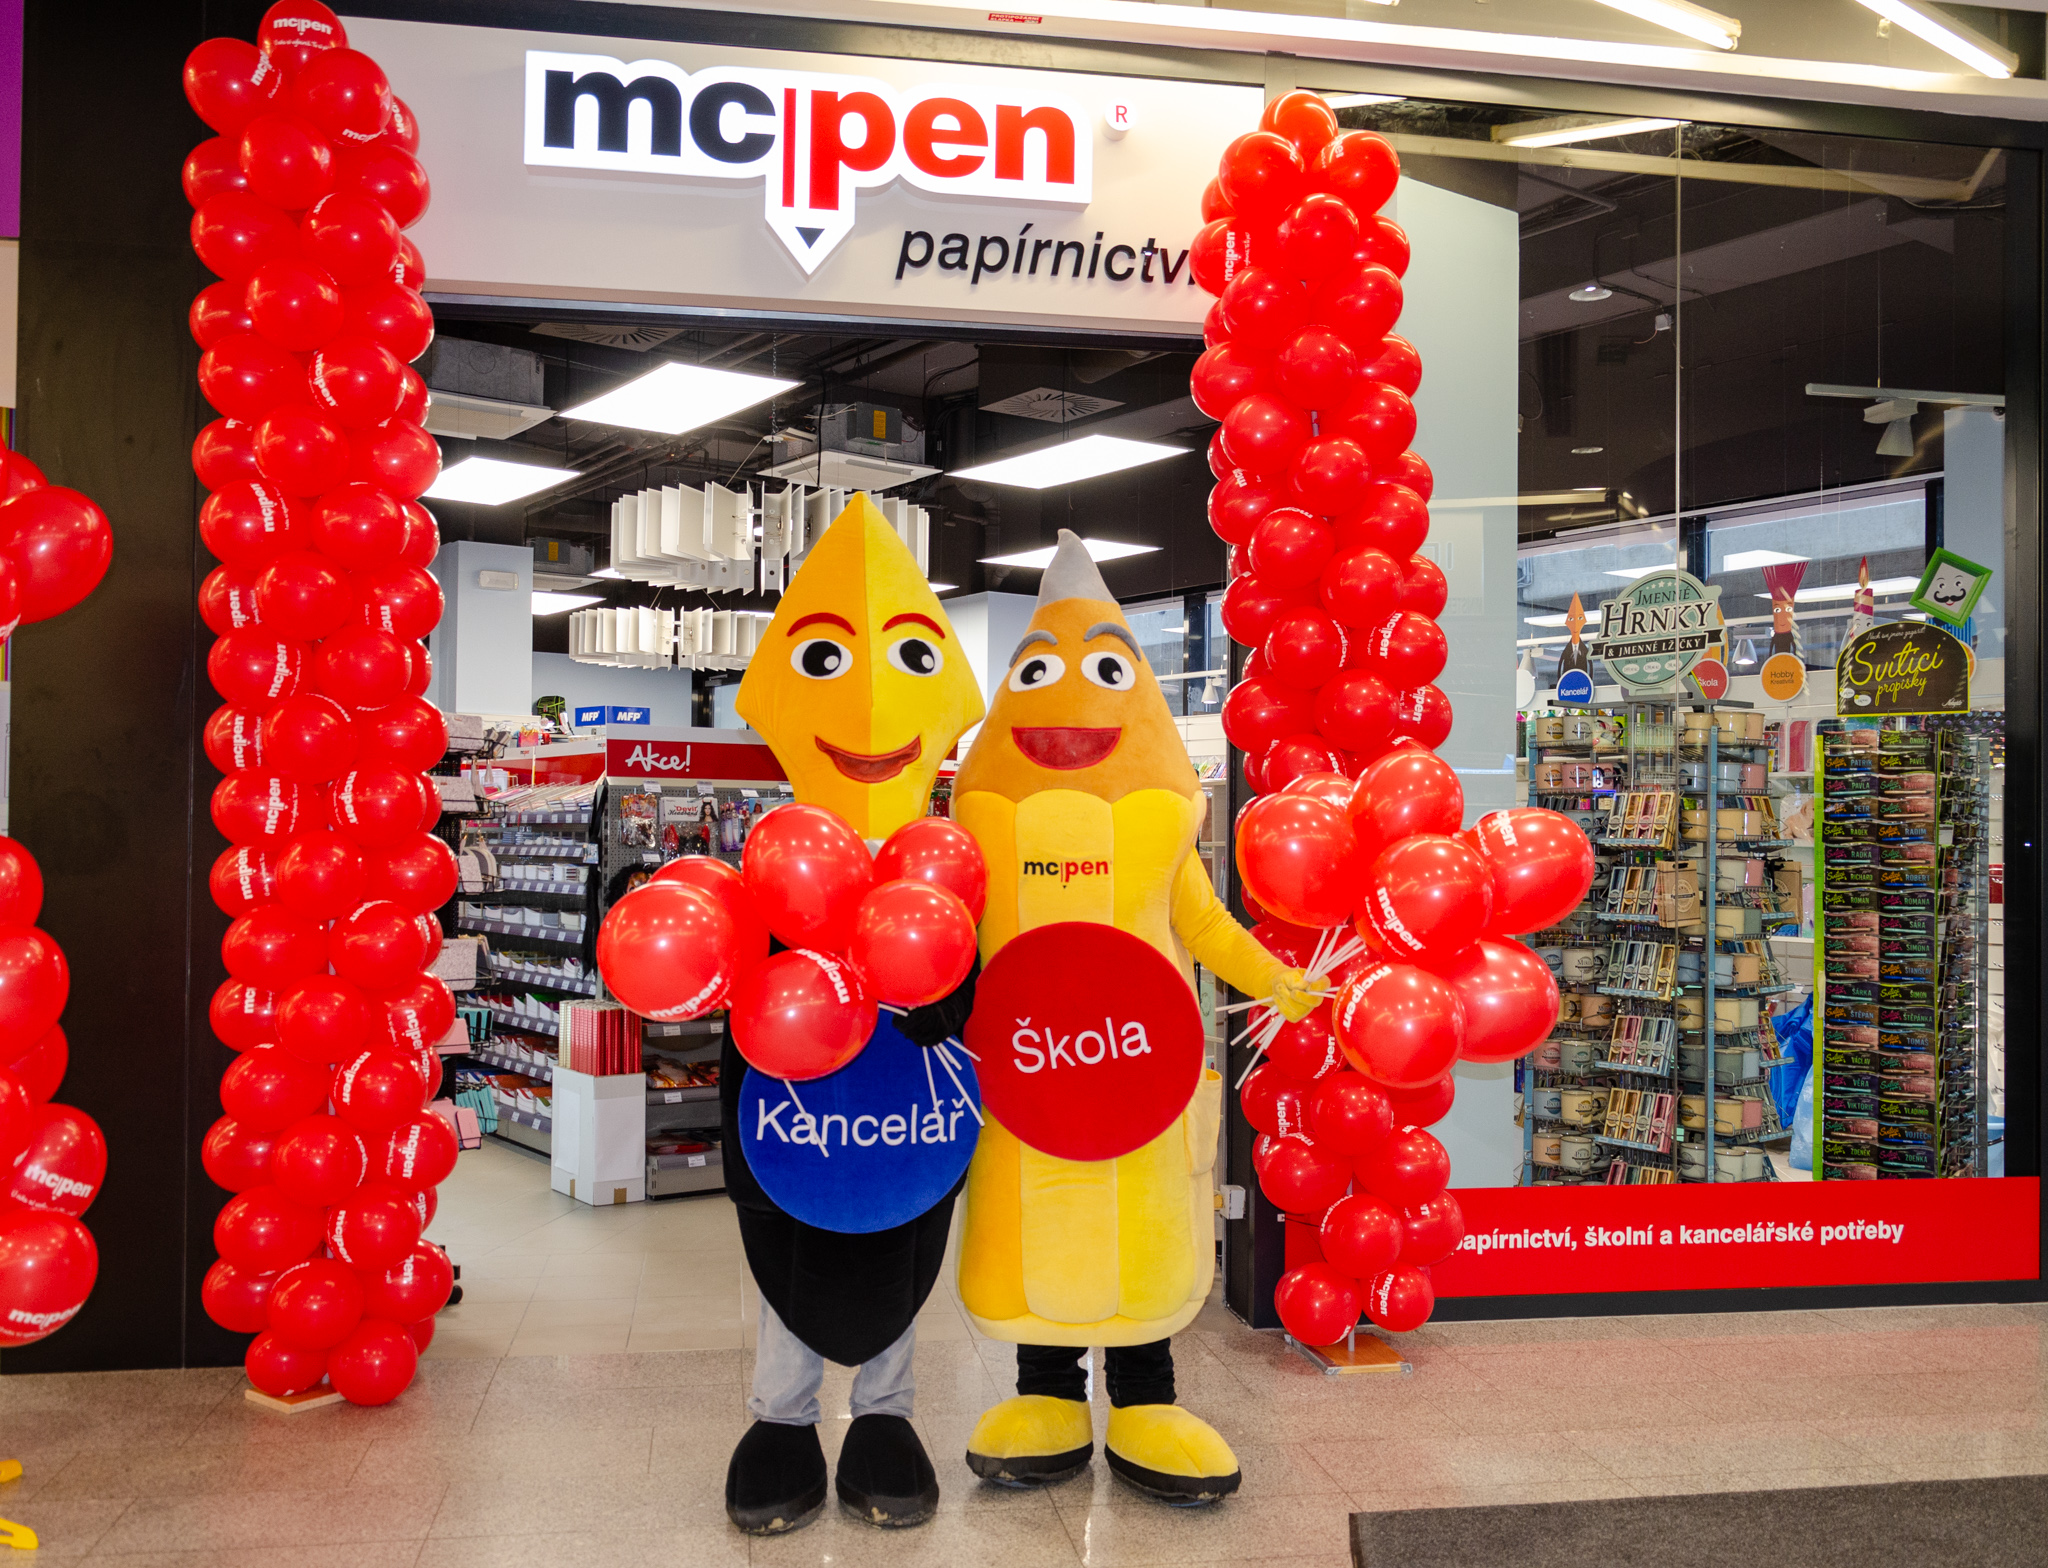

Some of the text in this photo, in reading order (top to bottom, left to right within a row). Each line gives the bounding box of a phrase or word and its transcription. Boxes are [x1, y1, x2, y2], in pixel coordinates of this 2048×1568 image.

[273, 17, 333, 35] mcpen
[543, 69, 1076, 211] mcpen
[896, 223, 1195, 285] papírnictv
[1223, 230, 1238, 282] mcpen
[313, 351, 338, 407] mcpen
[250, 483, 277, 532] mcpen
[230, 590, 248, 629] cpen
[1635, 586, 1690, 606] JMENNÉ
[1380, 612, 1403, 659] mcpen
[1601, 601, 1713, 638] HRNKY
[268, 642, 289, 697] mcpen
[1607, 638, 1701, 657] & JMENNÉ LŽČKY
[1560, 686, 1589, 697] Kancelář
[1770, 671, 1795, 679] Hobby
[1875, 668, 1928, 706] propisky
[581, 711, 599, 722] MFP
[617, 711, 641, 722] MFP
[1412, 686, 1426, 722] cpen
[232, 715, 247, 768] mcpen
[625, 742, 692, 773] Akce!
[264, 778, 284, 834] mcpen
[340, 771, 359, 824] mcpen
[239, 847, 255, 900] mcpen
[1023, 860, 1109, 883] mcpen
[1376, 886, 1427, 951] mcpen
[650, 973, 724, 1019] mcpen
[796, 948, 851, 1004] mcpen
[1343, 966, 1393, 1033] mcpen
[1012, 1017, 1152, 1074] Škola
[1312, 1036, 1336, 1080] mcpen
[343, 1051, 371, 1105] mcpen
[756, 1097, 967, 1147] Kancelář
[402, 1125, 421, 1179] mcpen
[24, 1164, 95, 1199] mcpen
[1584, 1225, 1653, 1247] školní
[1659, 1229, 1673, 1244] a
[1679, 1221, 1815, 1244] kancelářské
[1820, 1218, 1905, 1247] potřeby
[8, 1303, 82, 1329] mcpen
[1380, 1273, 1395, 1317] mcpen
